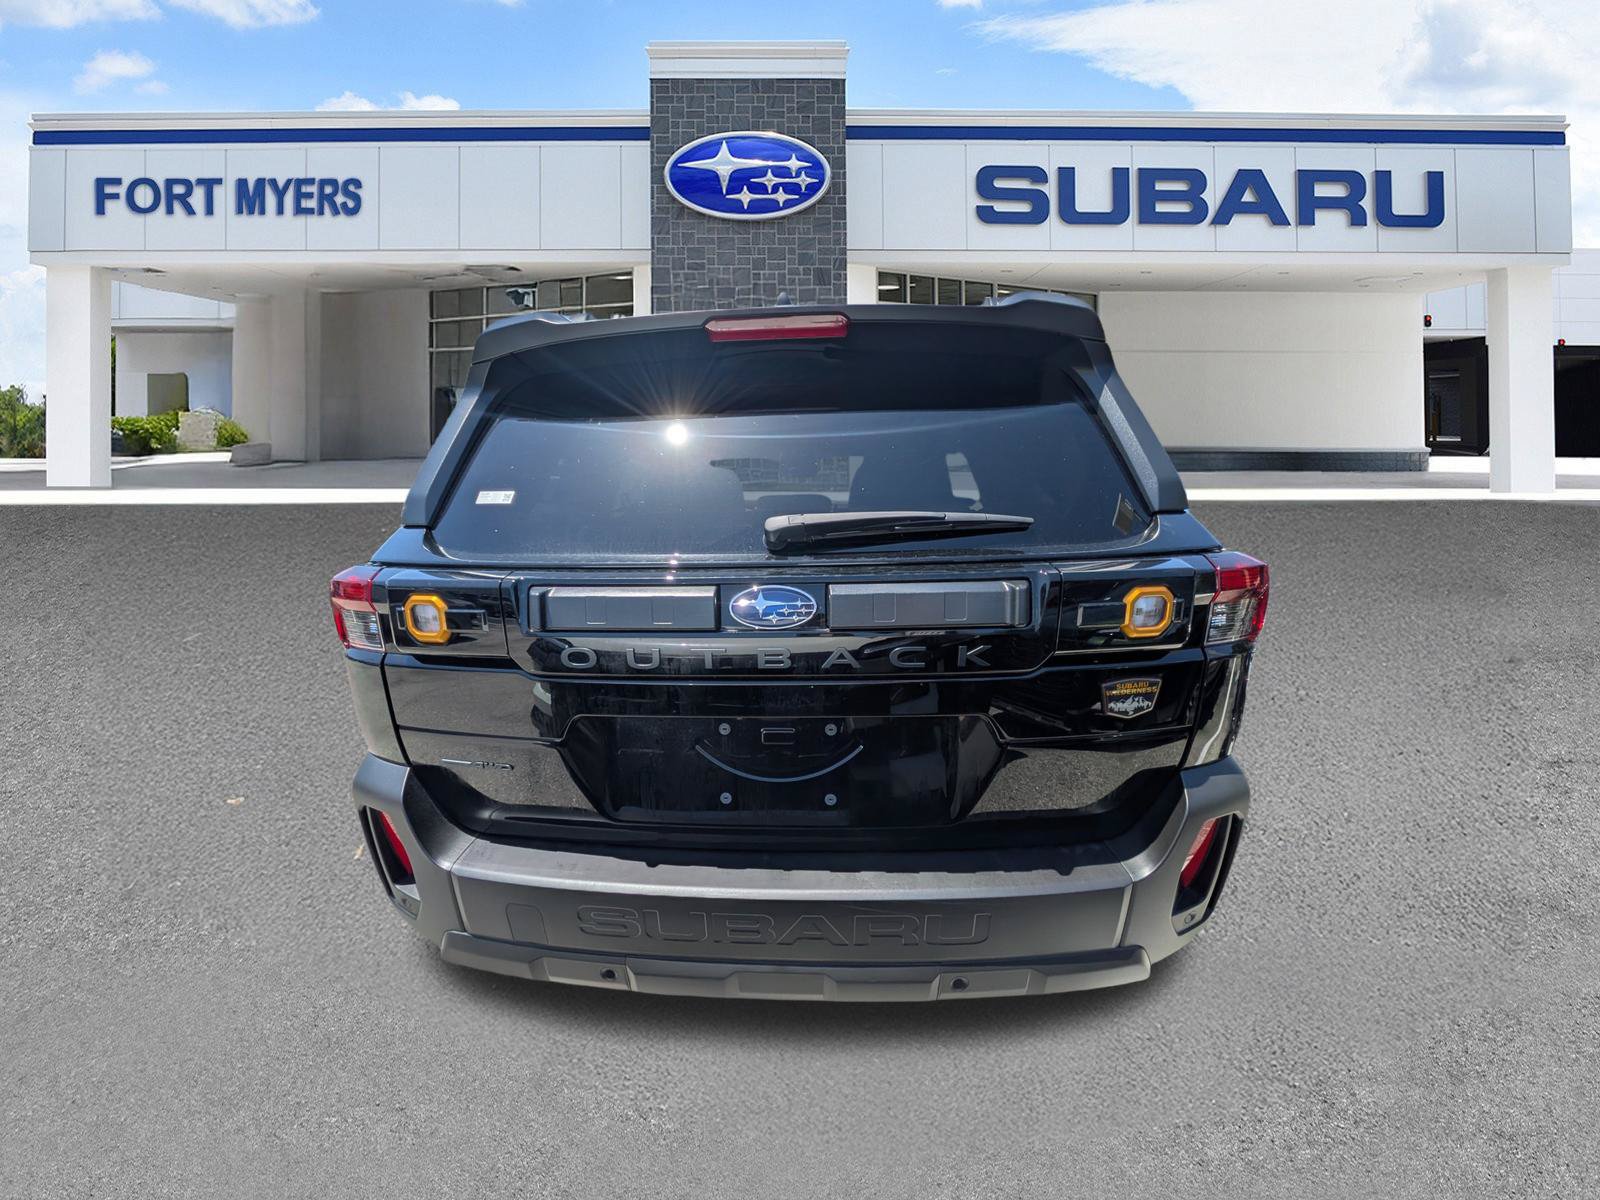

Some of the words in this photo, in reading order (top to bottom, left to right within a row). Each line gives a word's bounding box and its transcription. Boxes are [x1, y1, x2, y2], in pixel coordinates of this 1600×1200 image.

[94, 177, 223, 216] FORT
[235, 177, 363, 217] MYERS
[975, 164, 1446, 229] SUBARU
[560, 645, 993, 670] OUTBACK
[1116, 680, 1149, 690] SUBARU
[577, 905, 992, 946] SUBARU
